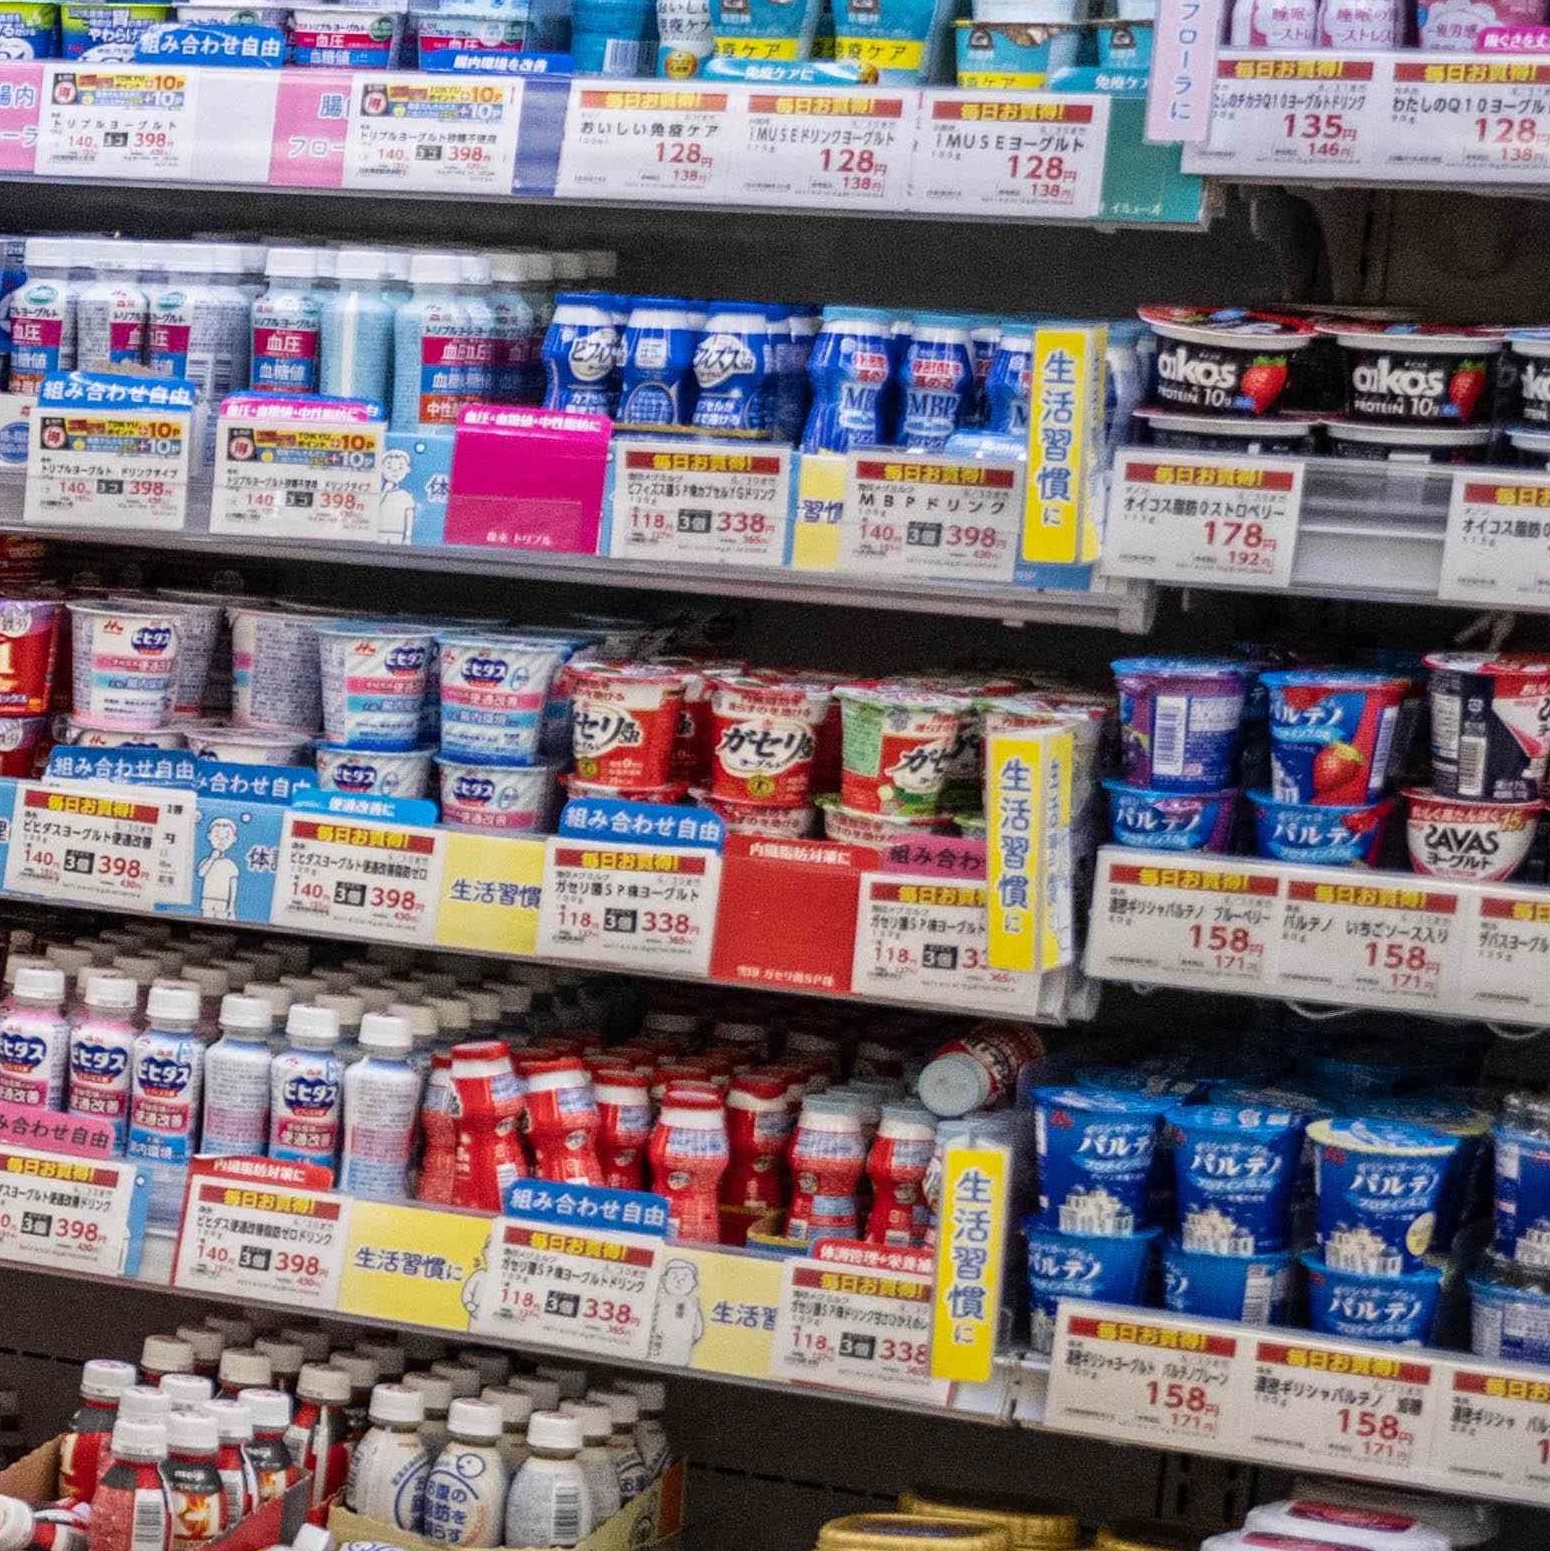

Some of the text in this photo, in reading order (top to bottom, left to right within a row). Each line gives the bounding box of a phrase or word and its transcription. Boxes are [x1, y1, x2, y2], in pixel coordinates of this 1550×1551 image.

[140, 32, 281, 59] 組み合わせ自由
[580, 119, 721, 141] おいしい免疫ケア
[1283, 114, 1357, 140] 135円
[655, 141, 713, 166] 128円
[819, 147, 888, 174] 128円
[1007, 154, 1077, 181] 128円
[44, 381, 192, 407] 組み合わせ自由
[1036, 349, 1076, 527] 生活習慣に
[717, 512, 775, 534] 338円
[1203, 520, 1277, 548] 178円
[563, 806, 721, 843] 組み合わせ自由
[996, 757, 1033, 934] 生活習慣に
[451, 877, 542, 911] 生活習慣
[641, 912, 700, 936] 338円
[1188, 925, 1264, 956] 158円
[1364, 941, 1441, 973] 158円
[1349, 1172, 1439, 1198] パルテノ
[511, 1187, 666, 1226] 組み合わせ自由
[355, 1246, 464, 1284] 生活習慣に
[947, 1169, 993, 1347] 生活習慣に
[585, 1298, 641, 1326] 338円
[1329, 1296, 1424, 1324] パルテノ
[1145, 1381, 1221, 1416] 158円
[1337, 1408, 1414, 1444] 158円
